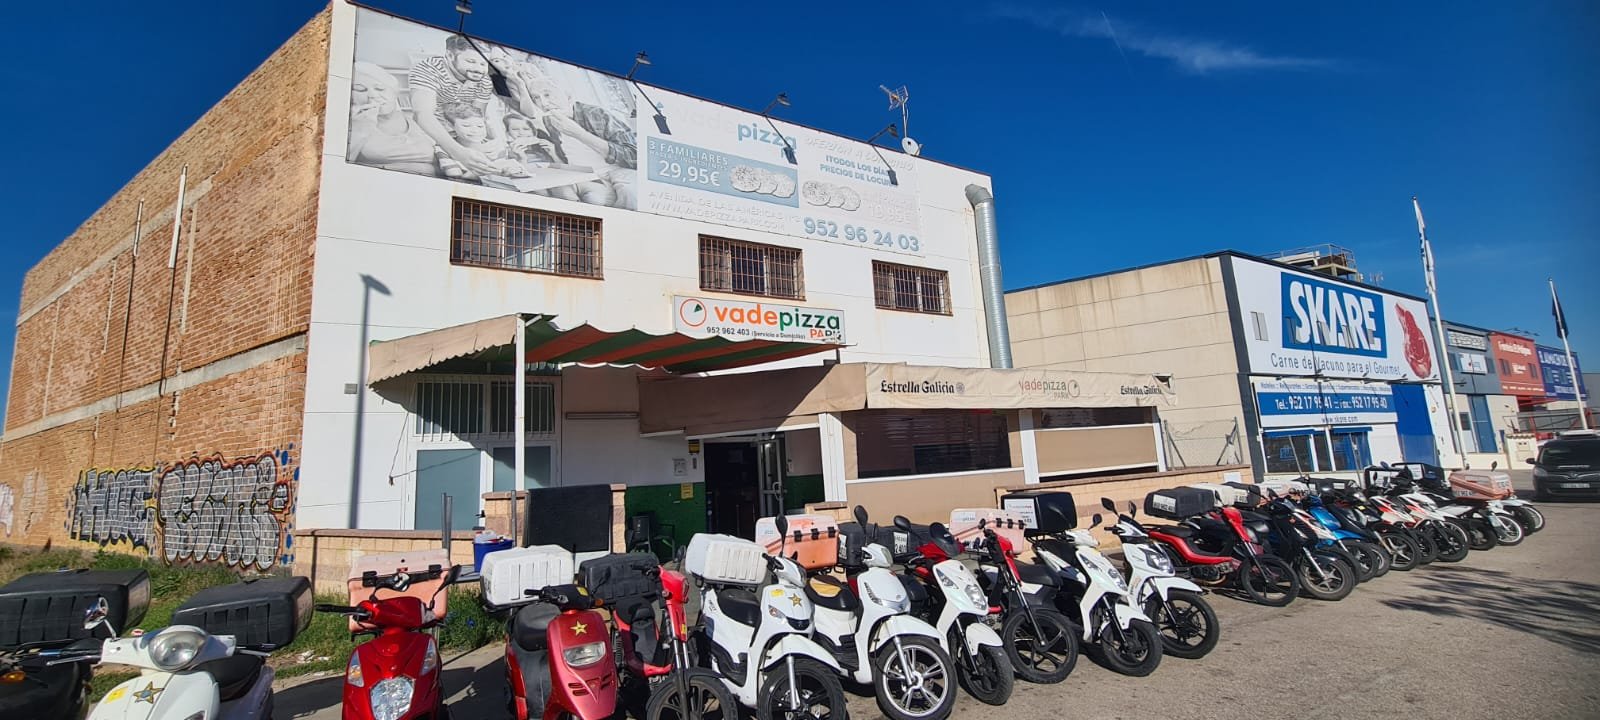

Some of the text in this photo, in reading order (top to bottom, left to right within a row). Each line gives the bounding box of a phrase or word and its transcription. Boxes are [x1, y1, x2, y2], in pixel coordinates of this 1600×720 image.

[649, 140, 728, 166] 3 FAMILIARES
[659, 160, 721, 187] 29,95€
[819, 164, 853, 179] PRECIOS
[854, 171, 865, 181] DE
[857, 162, 872, 173] LOS
[803, 216, 920, 252] 952 96 24 03
[714, 304, 841, 331] vadepizza
[1289, 280, 1383, 352] SKARE
[722, 328, 735, 336] 962
[737, 328, 750, 336] 403
[1271, 352, 1299, 369] Carne
[1302, 354, 1313, 370] de
[1347, 361, 1364, 376] para
[880, 380, 955, 394] Estrella Galicia
[1019, 379, 1067, 394] vadepizza
[1120, 385, 1143, 395] Estrella
[1288, 396, 1303, 410] 952
[1304, 396, 1313, 410] 17
[1364, 396, 1371, 409] 17
